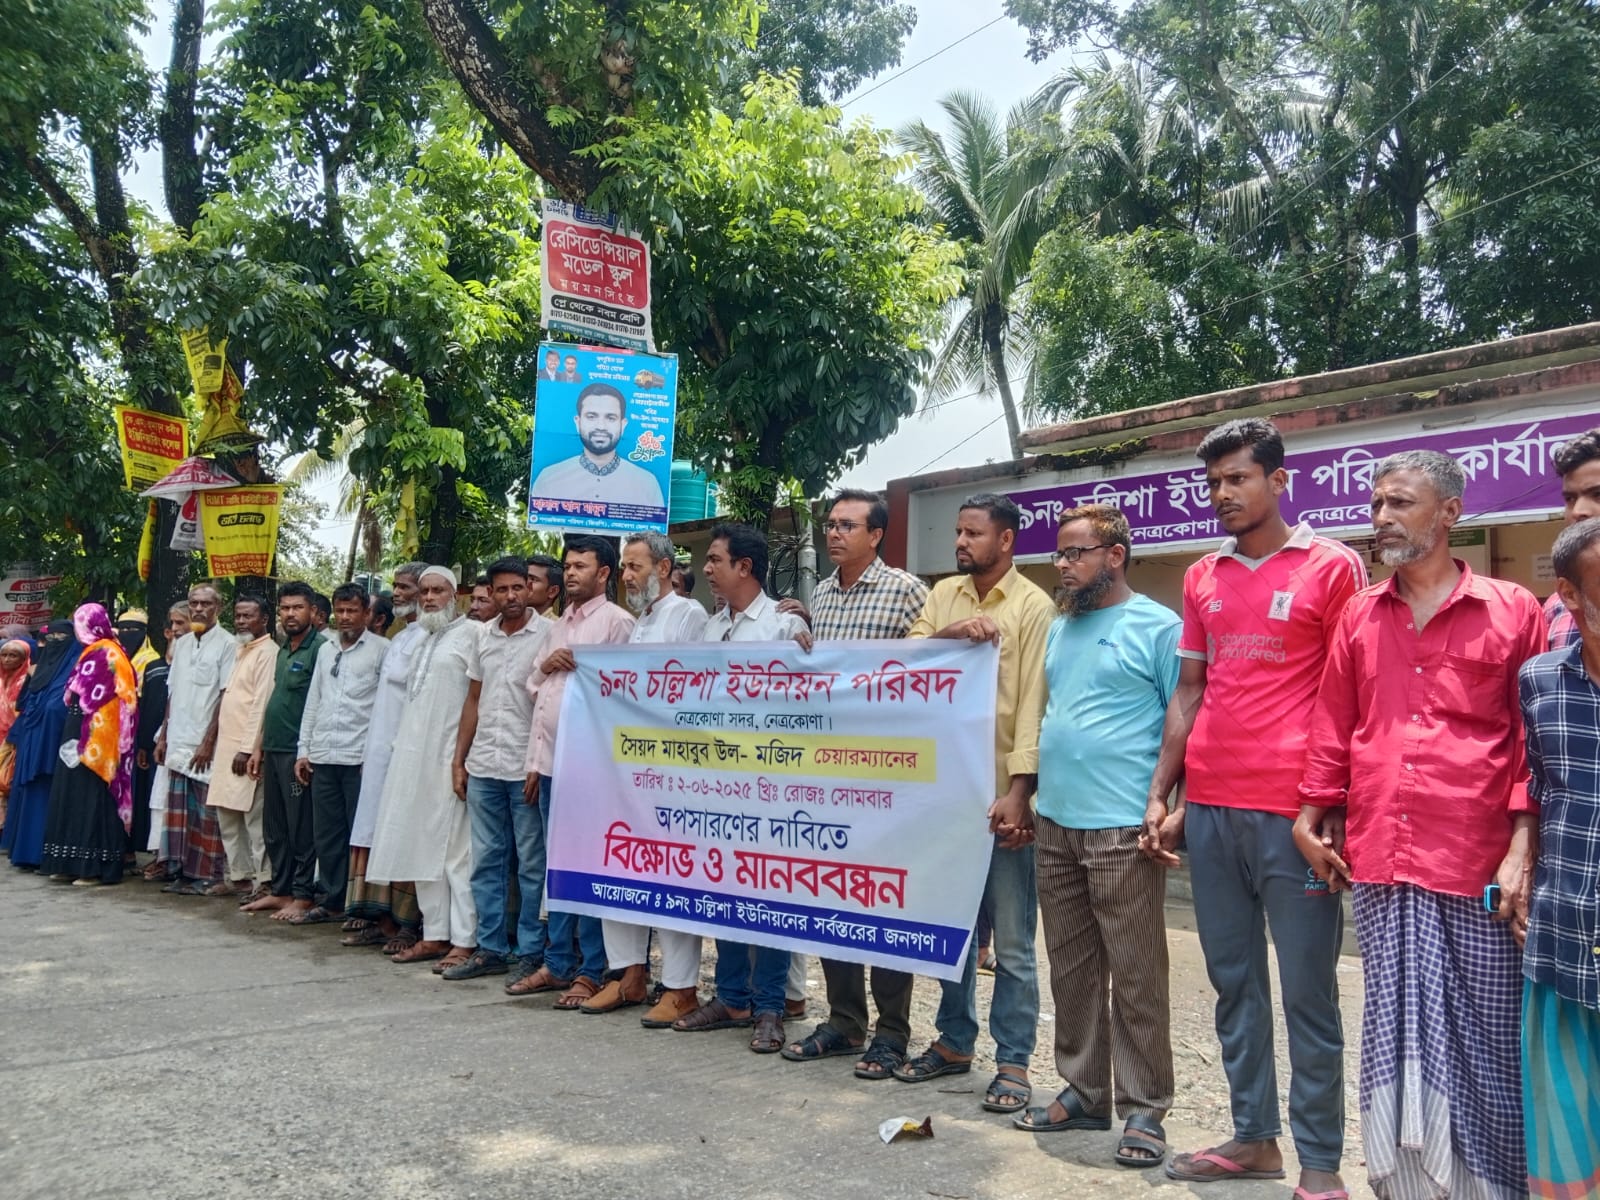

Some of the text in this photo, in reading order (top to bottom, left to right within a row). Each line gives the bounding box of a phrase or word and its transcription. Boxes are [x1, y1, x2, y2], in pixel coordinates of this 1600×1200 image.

[550, 226, 642, 268] রেসিডেন্সিয়াল
[561, 252, 634, 289] মডেল স্কুল
[569, 301, 595, 313] থেকে
[1219, 646, 1286, 664] chartered
[1220, 633, 1284, 649] standard
[599, 659, 963, 704] ৯নং চল্লিশা ইউনিয়ন পরিষদ
[675, 711, 725, 727] নেত্রকোণা
[728, 712, 760, 731] সদর,
[764, 712, 824, 730] নেত্রকোণা
[620, 732, 658, 758] সৈয়দ
[662, 739, 710, 766] মাহাবুব
[755, 738, 805, 767] মজিদ
[814, 747, 919, 769] চেয়ারম্যানের
[632, 768, 664, 792] তারিখ
[677, 776, 752, 800] ২-০৬-২০২৫
[831, 788, 893, 810] সোমবার
[654, 805, 852, 851] অপসারণের দাবিতে
[603, 821, 908, 909] বিক্ষোভ ও মানববন্ধন
[591, 882, 652, 906] আয়োজনে
[665, 893, 691, 914] ৯নং
[694, 894, 732, 920] চল্লিশা
[735, 899, 809, 932] ইউনিয়নের
[814, 913, 878, 943] সর্বস্তরের
[883, 926, 936, 953] জনগণ
